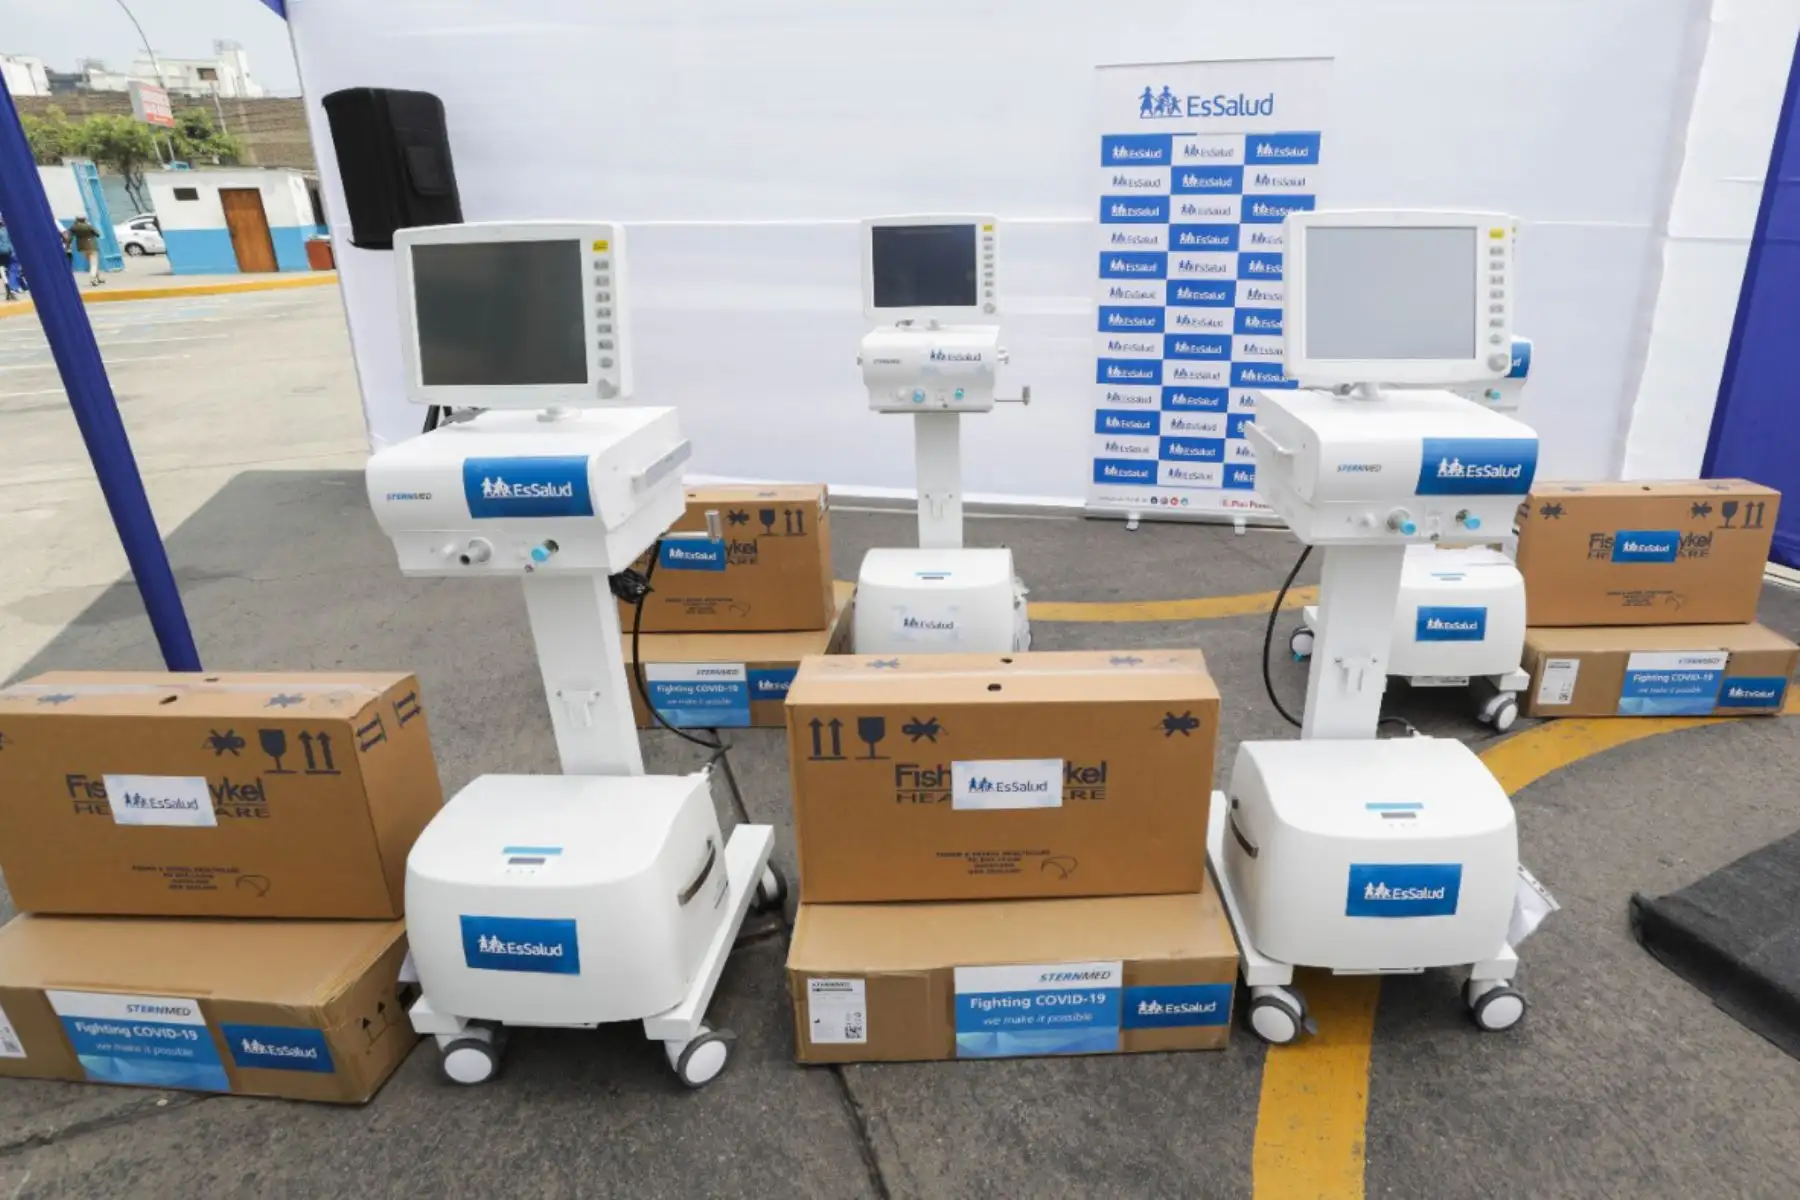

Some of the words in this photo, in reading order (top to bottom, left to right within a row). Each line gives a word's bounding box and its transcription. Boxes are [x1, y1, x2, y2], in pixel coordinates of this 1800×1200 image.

[1187, 93, 1274, 117] EsSalud
[1467, 465, 1521, 478] EsSalud
[514, 482, 572, 497] EsSalud
[896, 764, 951, 787] Fish
[209, 776, 267, 804] ykel
[997, 781, 1048, 792] EsSalud
[150, 798, 198, 810] EsSalud
[1392, 887, 1445, 900] EsSalud
[507, 943, 563, 957] EsSalud
[1039, 970, 1111, 983] STERNMED
[970, 995, 1031, 1011] Fighting
[1035, 993, 1106, 1006] COVID-19
[1165, 1002, 1216, 1015] EsSalud
[126, 1004, 191, 1016] STERNMED
[1003, 1014, 1035, 1025] make
[1036, 1014, 1045, 1023] it
[1046, 1012, 1093, 1024] possible
[75, 1021, 132, 1038] Fighting
[133, 1026, 198, 1040] COVID-19
[268, 1045, 318, 1059] EsSalud
